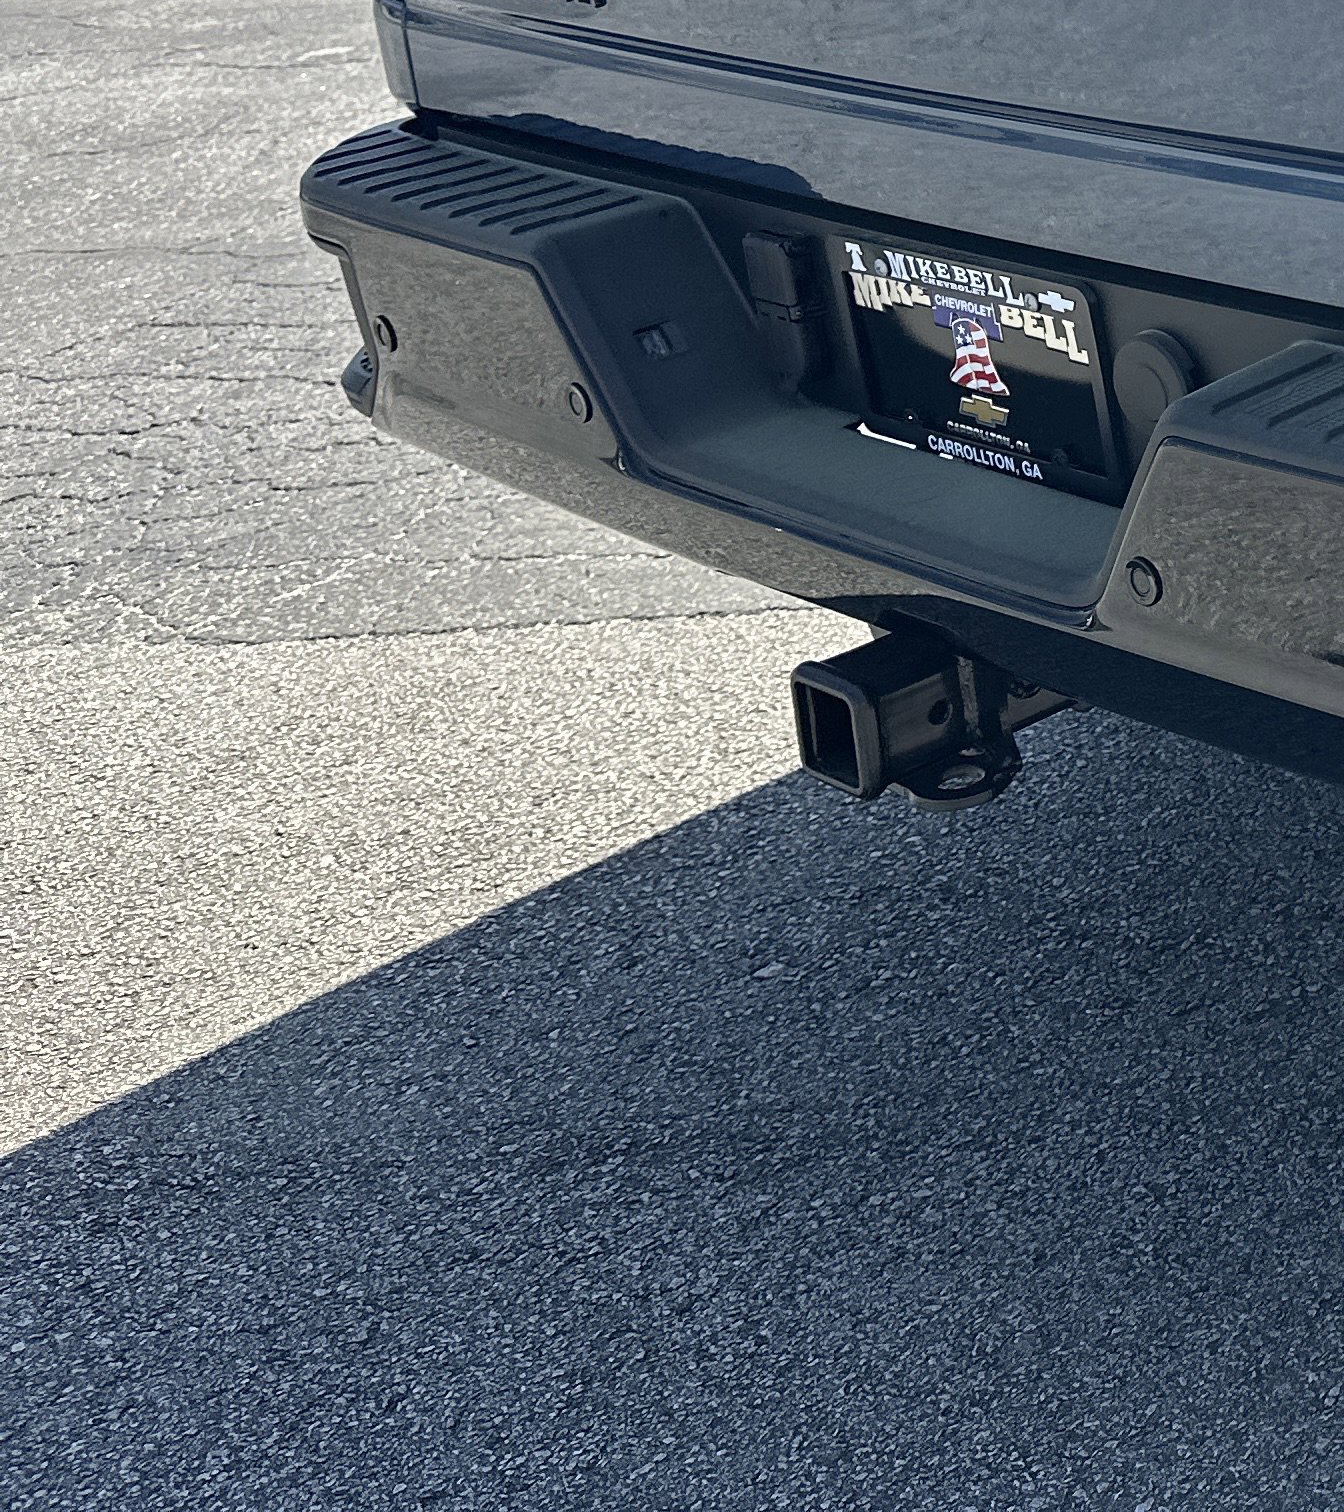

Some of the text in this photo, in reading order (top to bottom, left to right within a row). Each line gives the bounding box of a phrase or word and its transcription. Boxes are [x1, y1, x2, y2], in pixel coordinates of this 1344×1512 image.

[883, 249, 950, 282] MIKE
[950, 264, 1025, 307] BELL
[920, 275, 987, 297] CHEVROLET
[848, 271, 1090, 366] MIKE BELL
[934, 293, 994, 318] CHEVROLET
[927, 434, 1044, 480] CARROLLTON, GA
